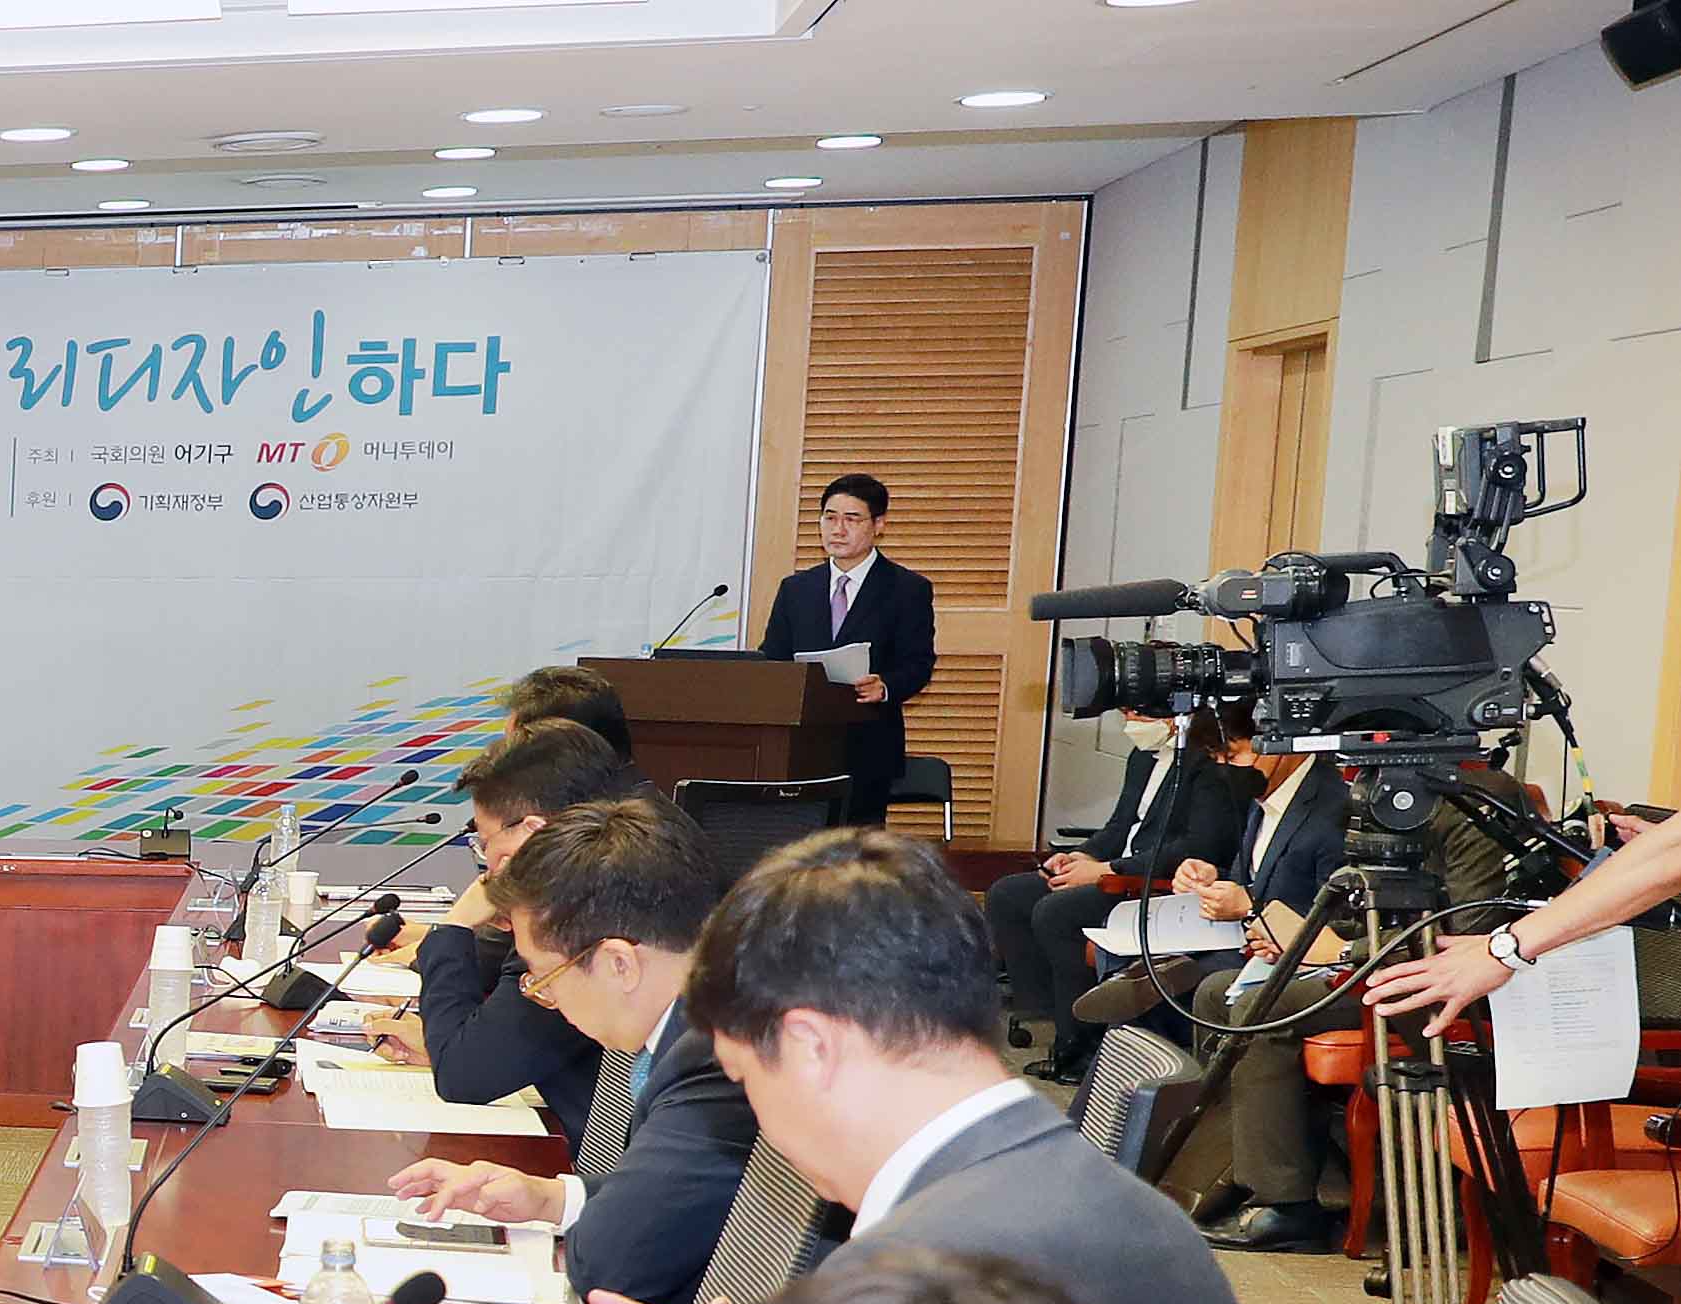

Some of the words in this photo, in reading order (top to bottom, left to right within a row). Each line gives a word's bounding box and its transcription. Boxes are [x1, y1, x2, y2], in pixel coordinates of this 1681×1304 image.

[26, 448, 59, 465] 주최
[90, 445, 166, 465] 국회의원
[174, 444, 234, 465] 어기구
[256, 441, 306, 464] MT
[363, 439, 455, 461] 머니투데이
[24, 490, 57, 508] 후원
[138, 492, 224, 512] 기획재정부
[298, 492, 418, 511] 산업통상자원부
